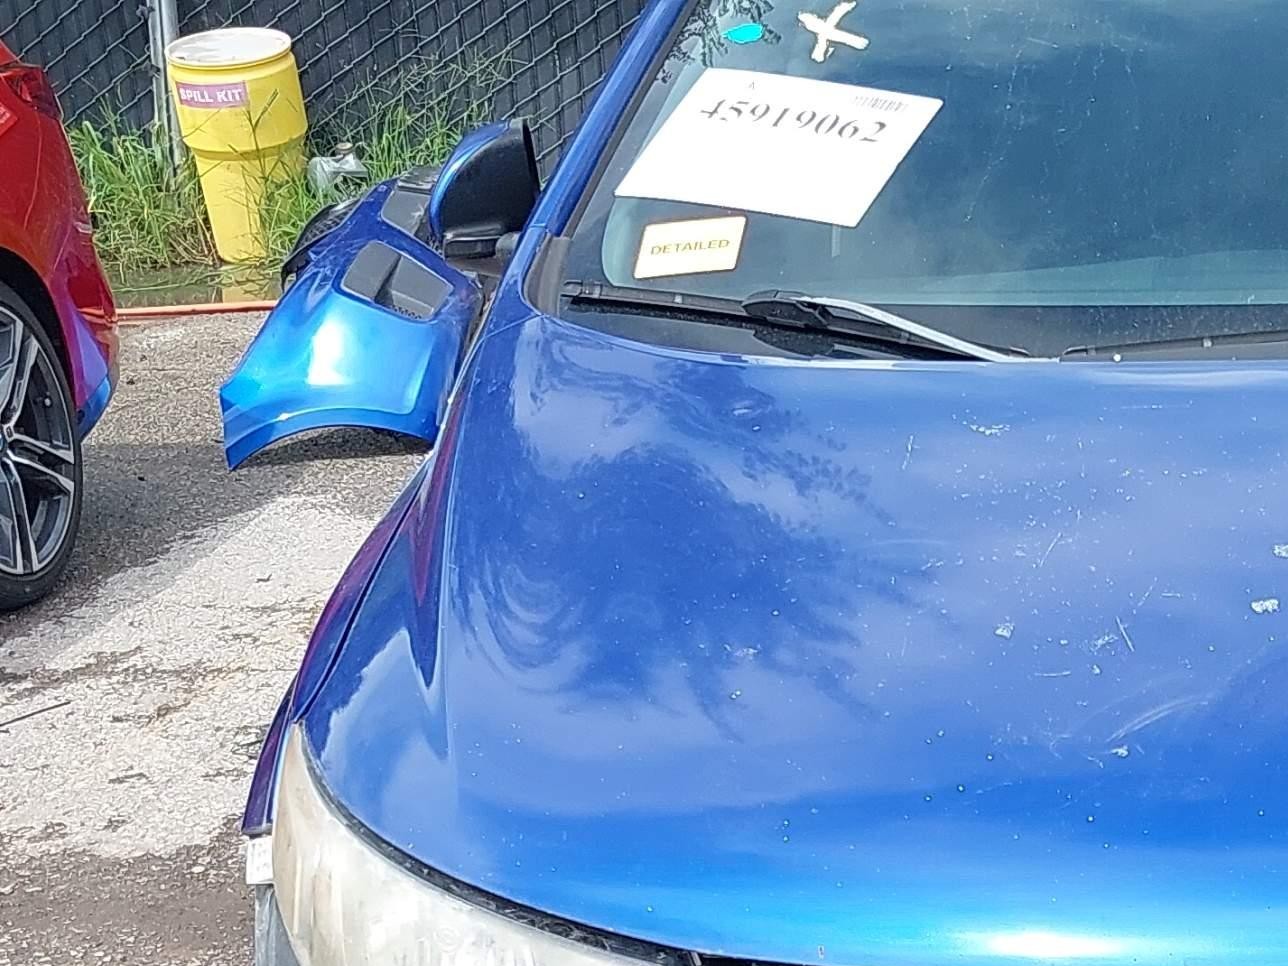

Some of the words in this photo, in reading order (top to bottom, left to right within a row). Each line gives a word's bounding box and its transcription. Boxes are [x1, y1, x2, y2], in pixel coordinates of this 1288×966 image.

[179, 87, 214, 103] SPILL
[217, 87, 244, 103] KIT
[701, 99, 887, 143] 45919062
[651, 239, 730, 256] DETAILED
